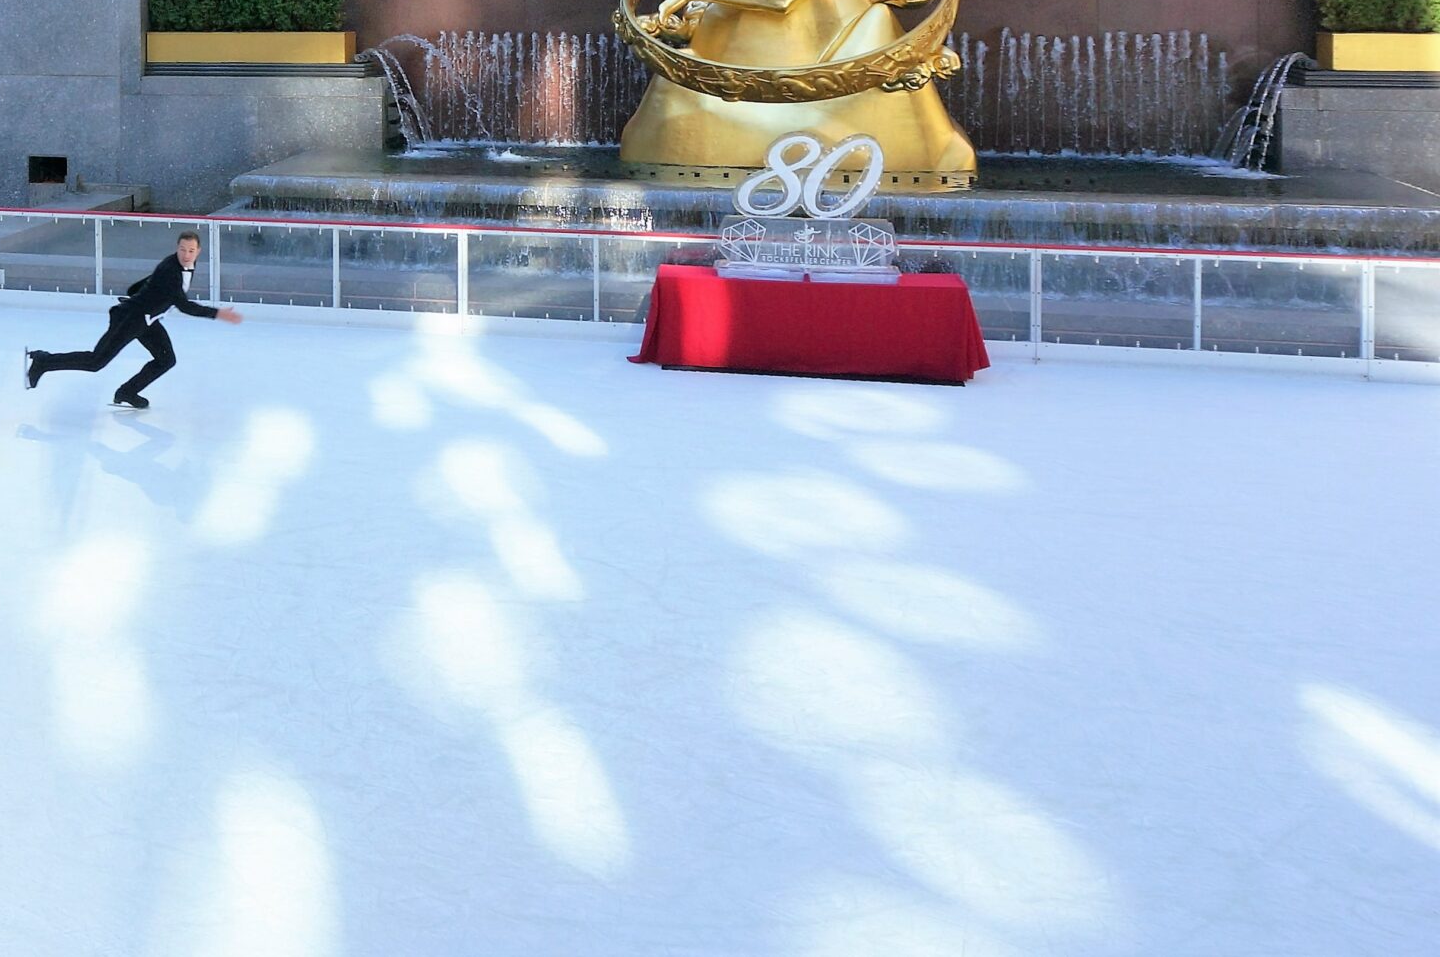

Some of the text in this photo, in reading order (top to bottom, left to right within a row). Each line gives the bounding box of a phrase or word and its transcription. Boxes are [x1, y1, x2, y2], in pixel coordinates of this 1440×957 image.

[737, 135, 884, 218] 80
[771, 242, 840, 259] THE RINK
